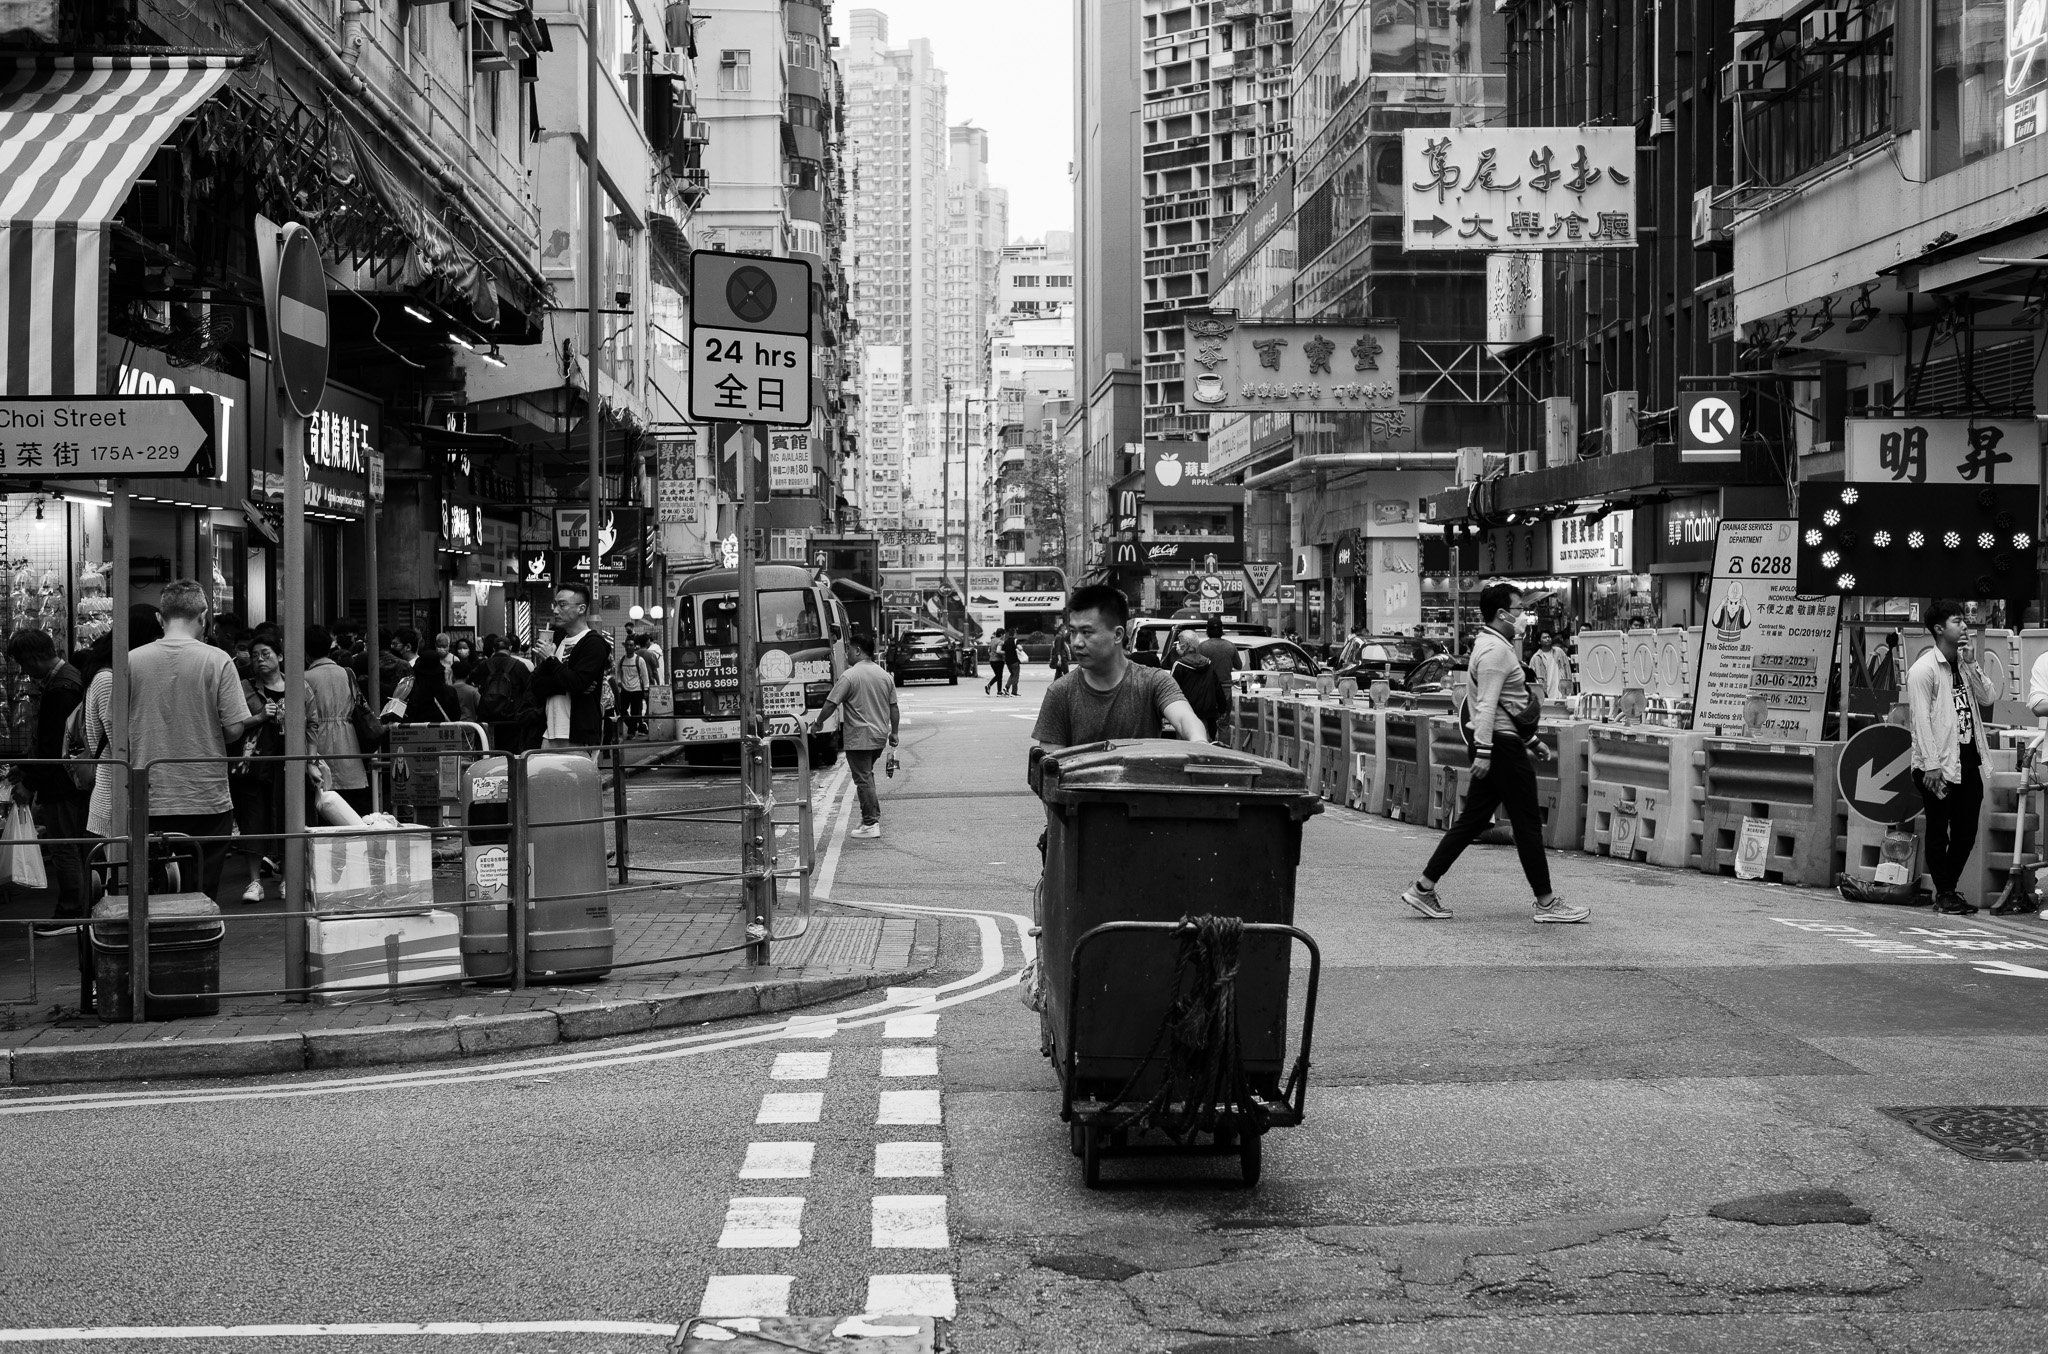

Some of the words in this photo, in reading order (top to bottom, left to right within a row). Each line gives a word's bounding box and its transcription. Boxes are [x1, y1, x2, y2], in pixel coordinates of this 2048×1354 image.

[705, 337, 743, 364] 24
[755, 342, 797, 369] hrs
[714, 373, 784, 412] 全日
[54, 408, 127, 427] Street
[1722, 523, 1747, 531] DRAINAGE
[1748, 523, 1772, 531] SERVICES
[1751, 556, 1791, 574] 6288
[1757, 603, 1794, 615] 不便之處
[1788, 628, 1832, 638] DC/2019/12
[1706, 642, 1717, 651] This
[1718, 643, 1738, 652] Section
[686, 668, 711, 678] 3707
[714, 666, 738, 676] 1136
[687, 680, 712, 689] 6366
[714, 678, 739, 688] 3699
[720, 700, 741, 709] 722
[1708, 711, 1730, 720] Sections
[1645, 797, 1656, 811] T2
